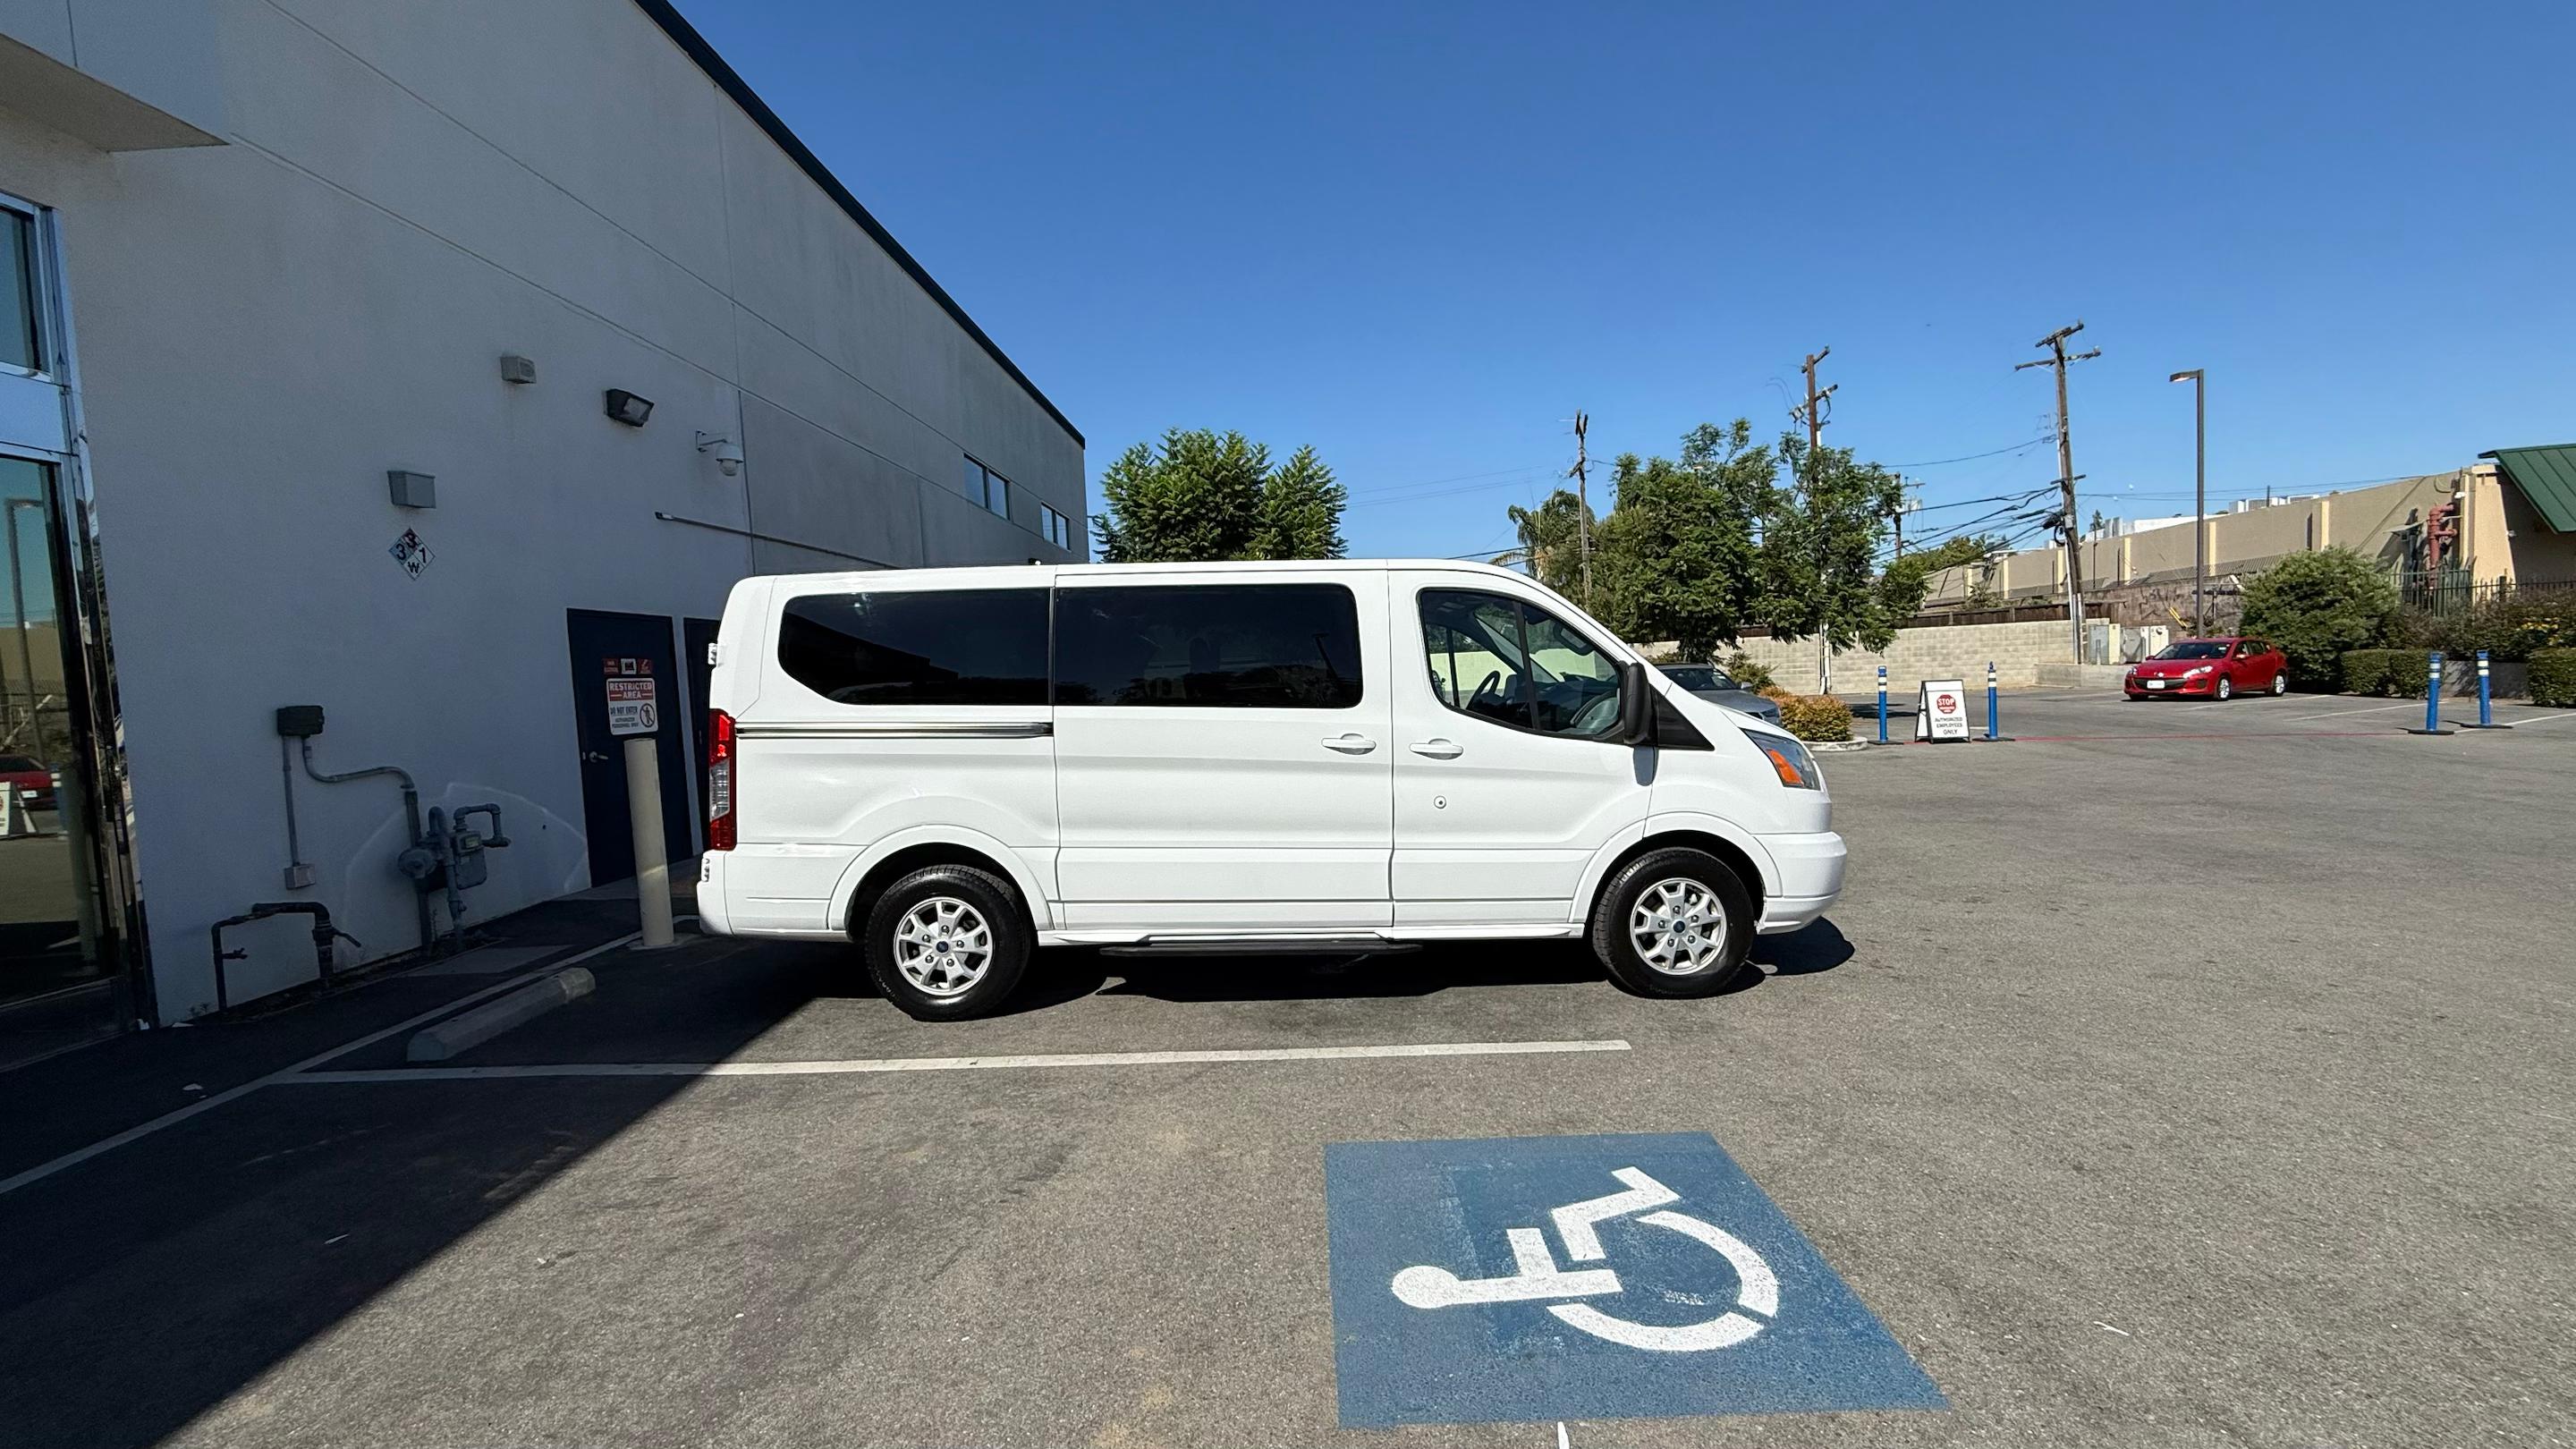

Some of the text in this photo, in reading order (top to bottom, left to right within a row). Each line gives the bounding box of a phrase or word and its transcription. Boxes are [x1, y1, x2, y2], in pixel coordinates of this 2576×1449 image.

[395, 543, 407, 560] 3
[419, 547, 426, 564] 1
[408, 561, 419, 573] W
[609, 682, 652, 691] RESTRICTED
[623, 691, 641, 699] AREA
[1938, 698, 1955, 707] STOP
